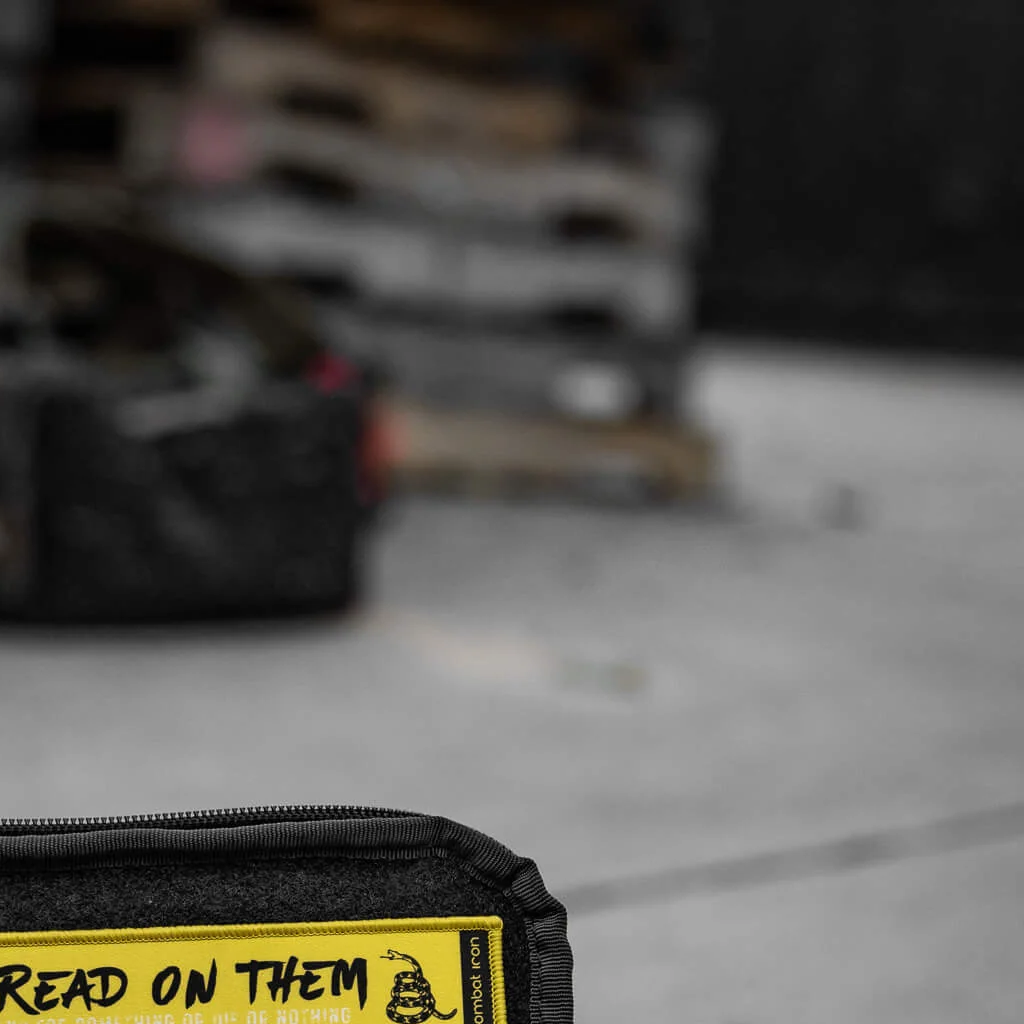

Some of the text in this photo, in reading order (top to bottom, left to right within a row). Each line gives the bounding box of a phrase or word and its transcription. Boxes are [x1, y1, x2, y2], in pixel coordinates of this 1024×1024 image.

[469, 936, 482, 969] iron
[151, 958, 218, 1010] ON
[234, 955, 368, 1010] THEM
